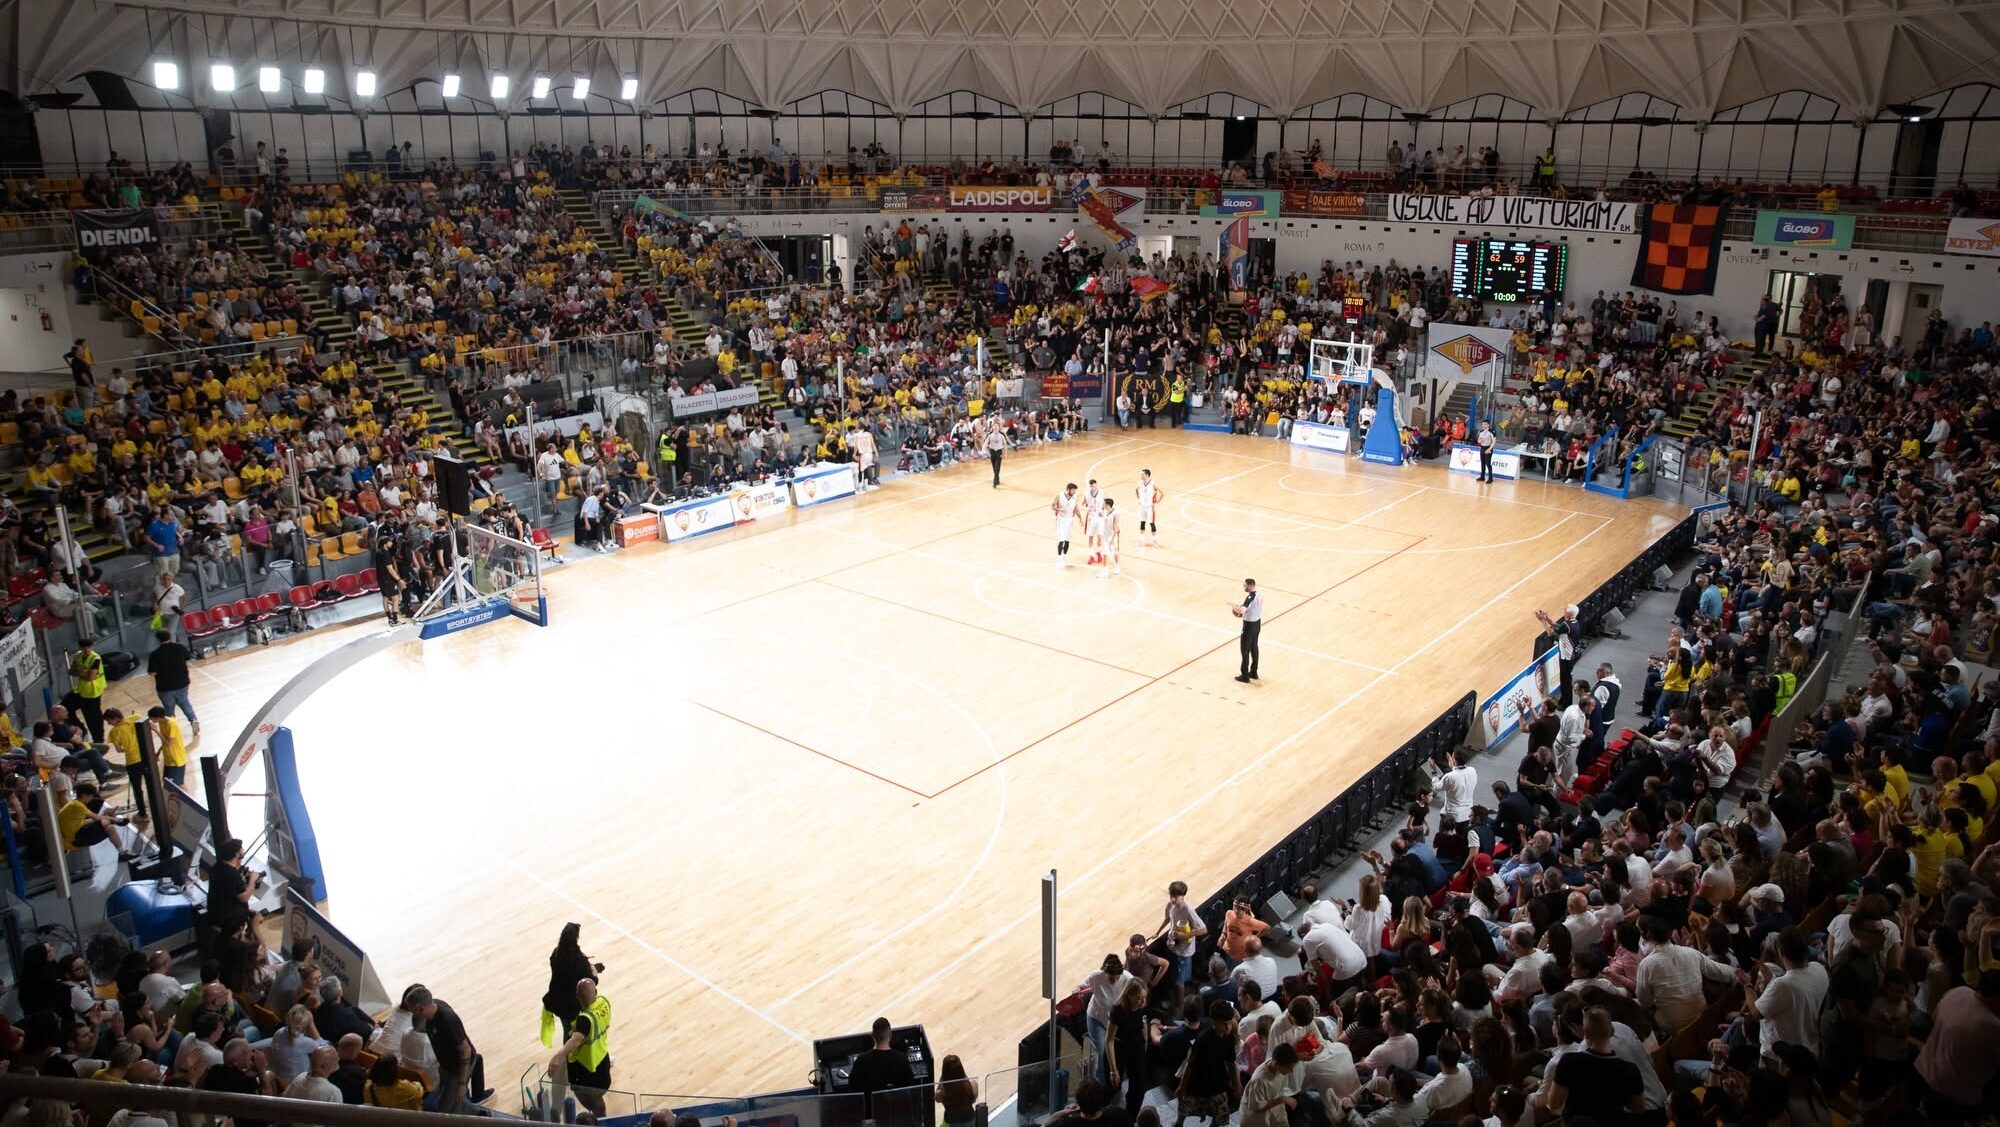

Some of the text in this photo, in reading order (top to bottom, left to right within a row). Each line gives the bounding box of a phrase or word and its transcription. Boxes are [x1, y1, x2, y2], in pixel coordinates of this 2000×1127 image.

[950, 190, 1051, 206] LADISPOLI
[1222, 199, 1254, 208] GLOBO
[1312, 194, 1332, 206] DAJE
[1333, 195, 1357, 206] VIRTUS
[1393, 194, 1458, 221] USQUE
[1467, 197, 1495, 223] AD
[1503, 197, 1628, 231] VICTORIAM!
[1279, 230, 1304, 238] OVEST
[1782, 224, 1819, 235] GLOBO
[80, 226, 158, 247] DIENDI.
[1344, 243, 1372, 251] ROMA
[1490, 254, 1501, 262] 62
[1514, 255, 1525, 263] 59
[1726, 255, 1754, 264] OVEST
[1493, 292, 1516, 301] 10:00
[1454, 343, 1483, 360] VIRTUS
[1135, 379, 1155, 390] RM
[676, 399, 712, 410] PALAZZETTO
[738, 392, 756, 400] SPORT
